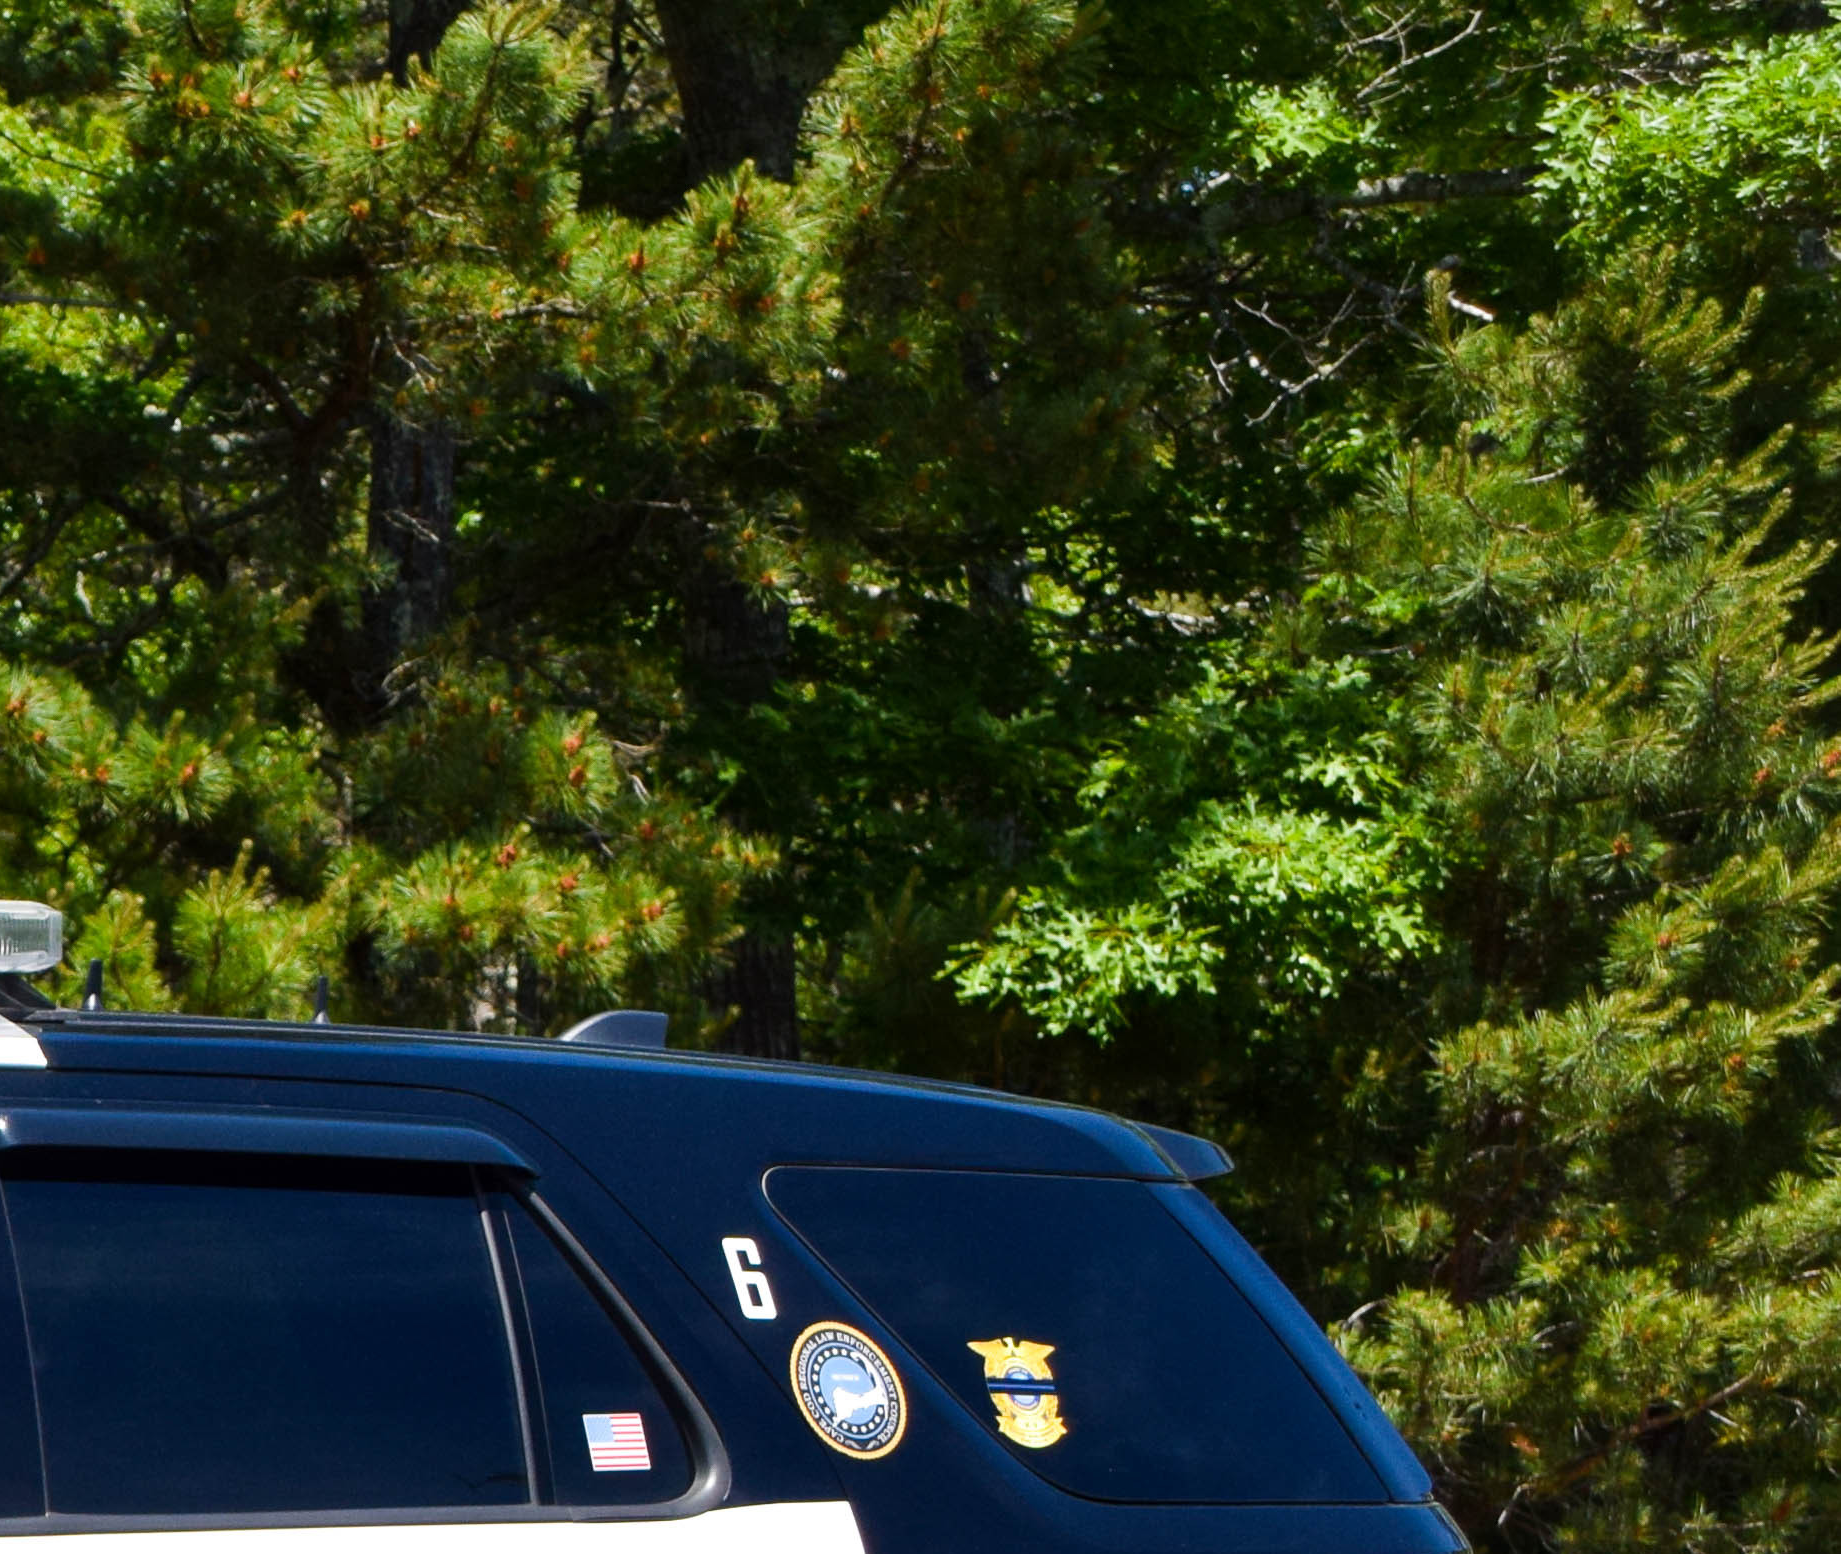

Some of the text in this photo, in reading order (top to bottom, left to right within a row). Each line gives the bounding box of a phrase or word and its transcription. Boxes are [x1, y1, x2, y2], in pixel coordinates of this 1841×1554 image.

[721, 1237, 777, 1320] 6
[815, 1331, 835, 1344] LAW
[798, 1337, 817, 1390] REGIONAL
[836, 1331, 897, 1401] ENFORCEMENT
[803, 1393, 820, 1419] COD
[877, 1402, 898, 1443] COUNCIL
[818, 1420, 845, 1443] CAPE
